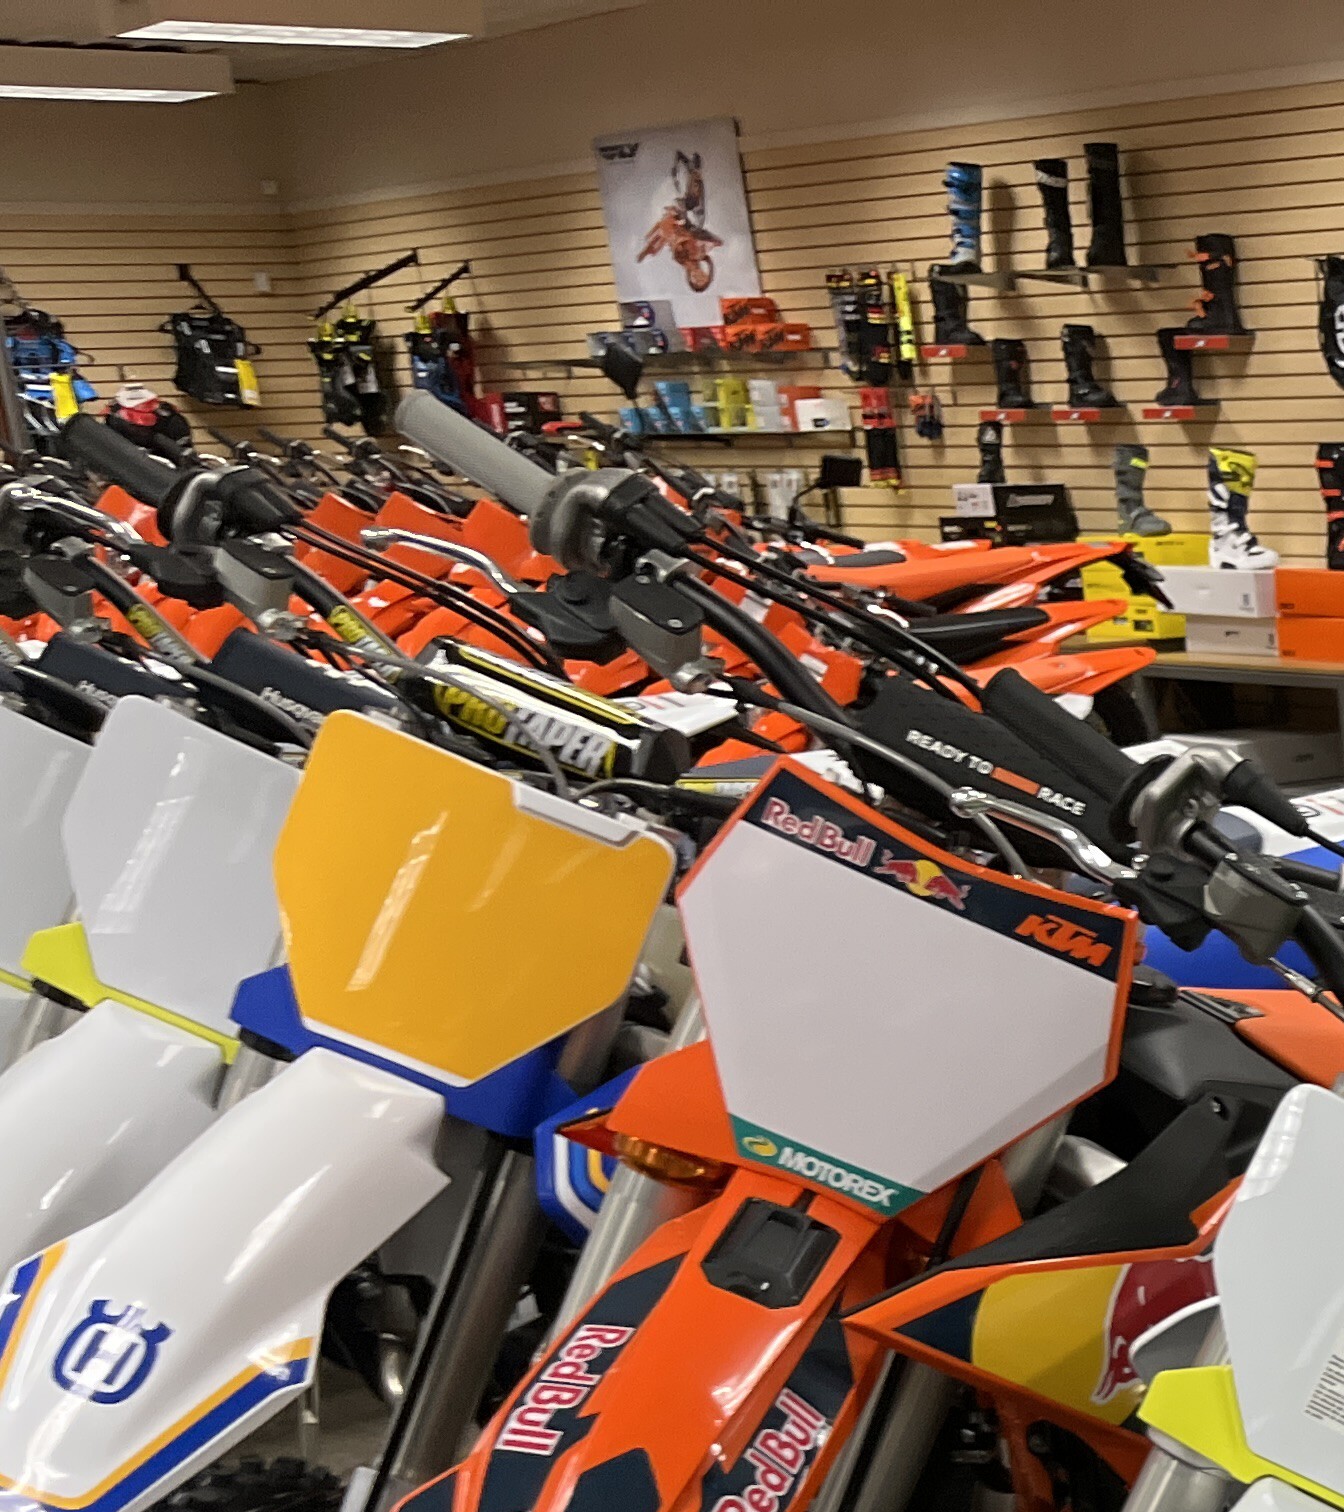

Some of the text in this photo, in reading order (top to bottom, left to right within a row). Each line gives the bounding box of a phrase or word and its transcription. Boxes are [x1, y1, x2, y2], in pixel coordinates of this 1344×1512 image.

[905, 730, 1087, 817] READY TO RACE
[1013, 914, 1113, 967] KTM
[777, 1146, 900, 1208] MOTOREX
